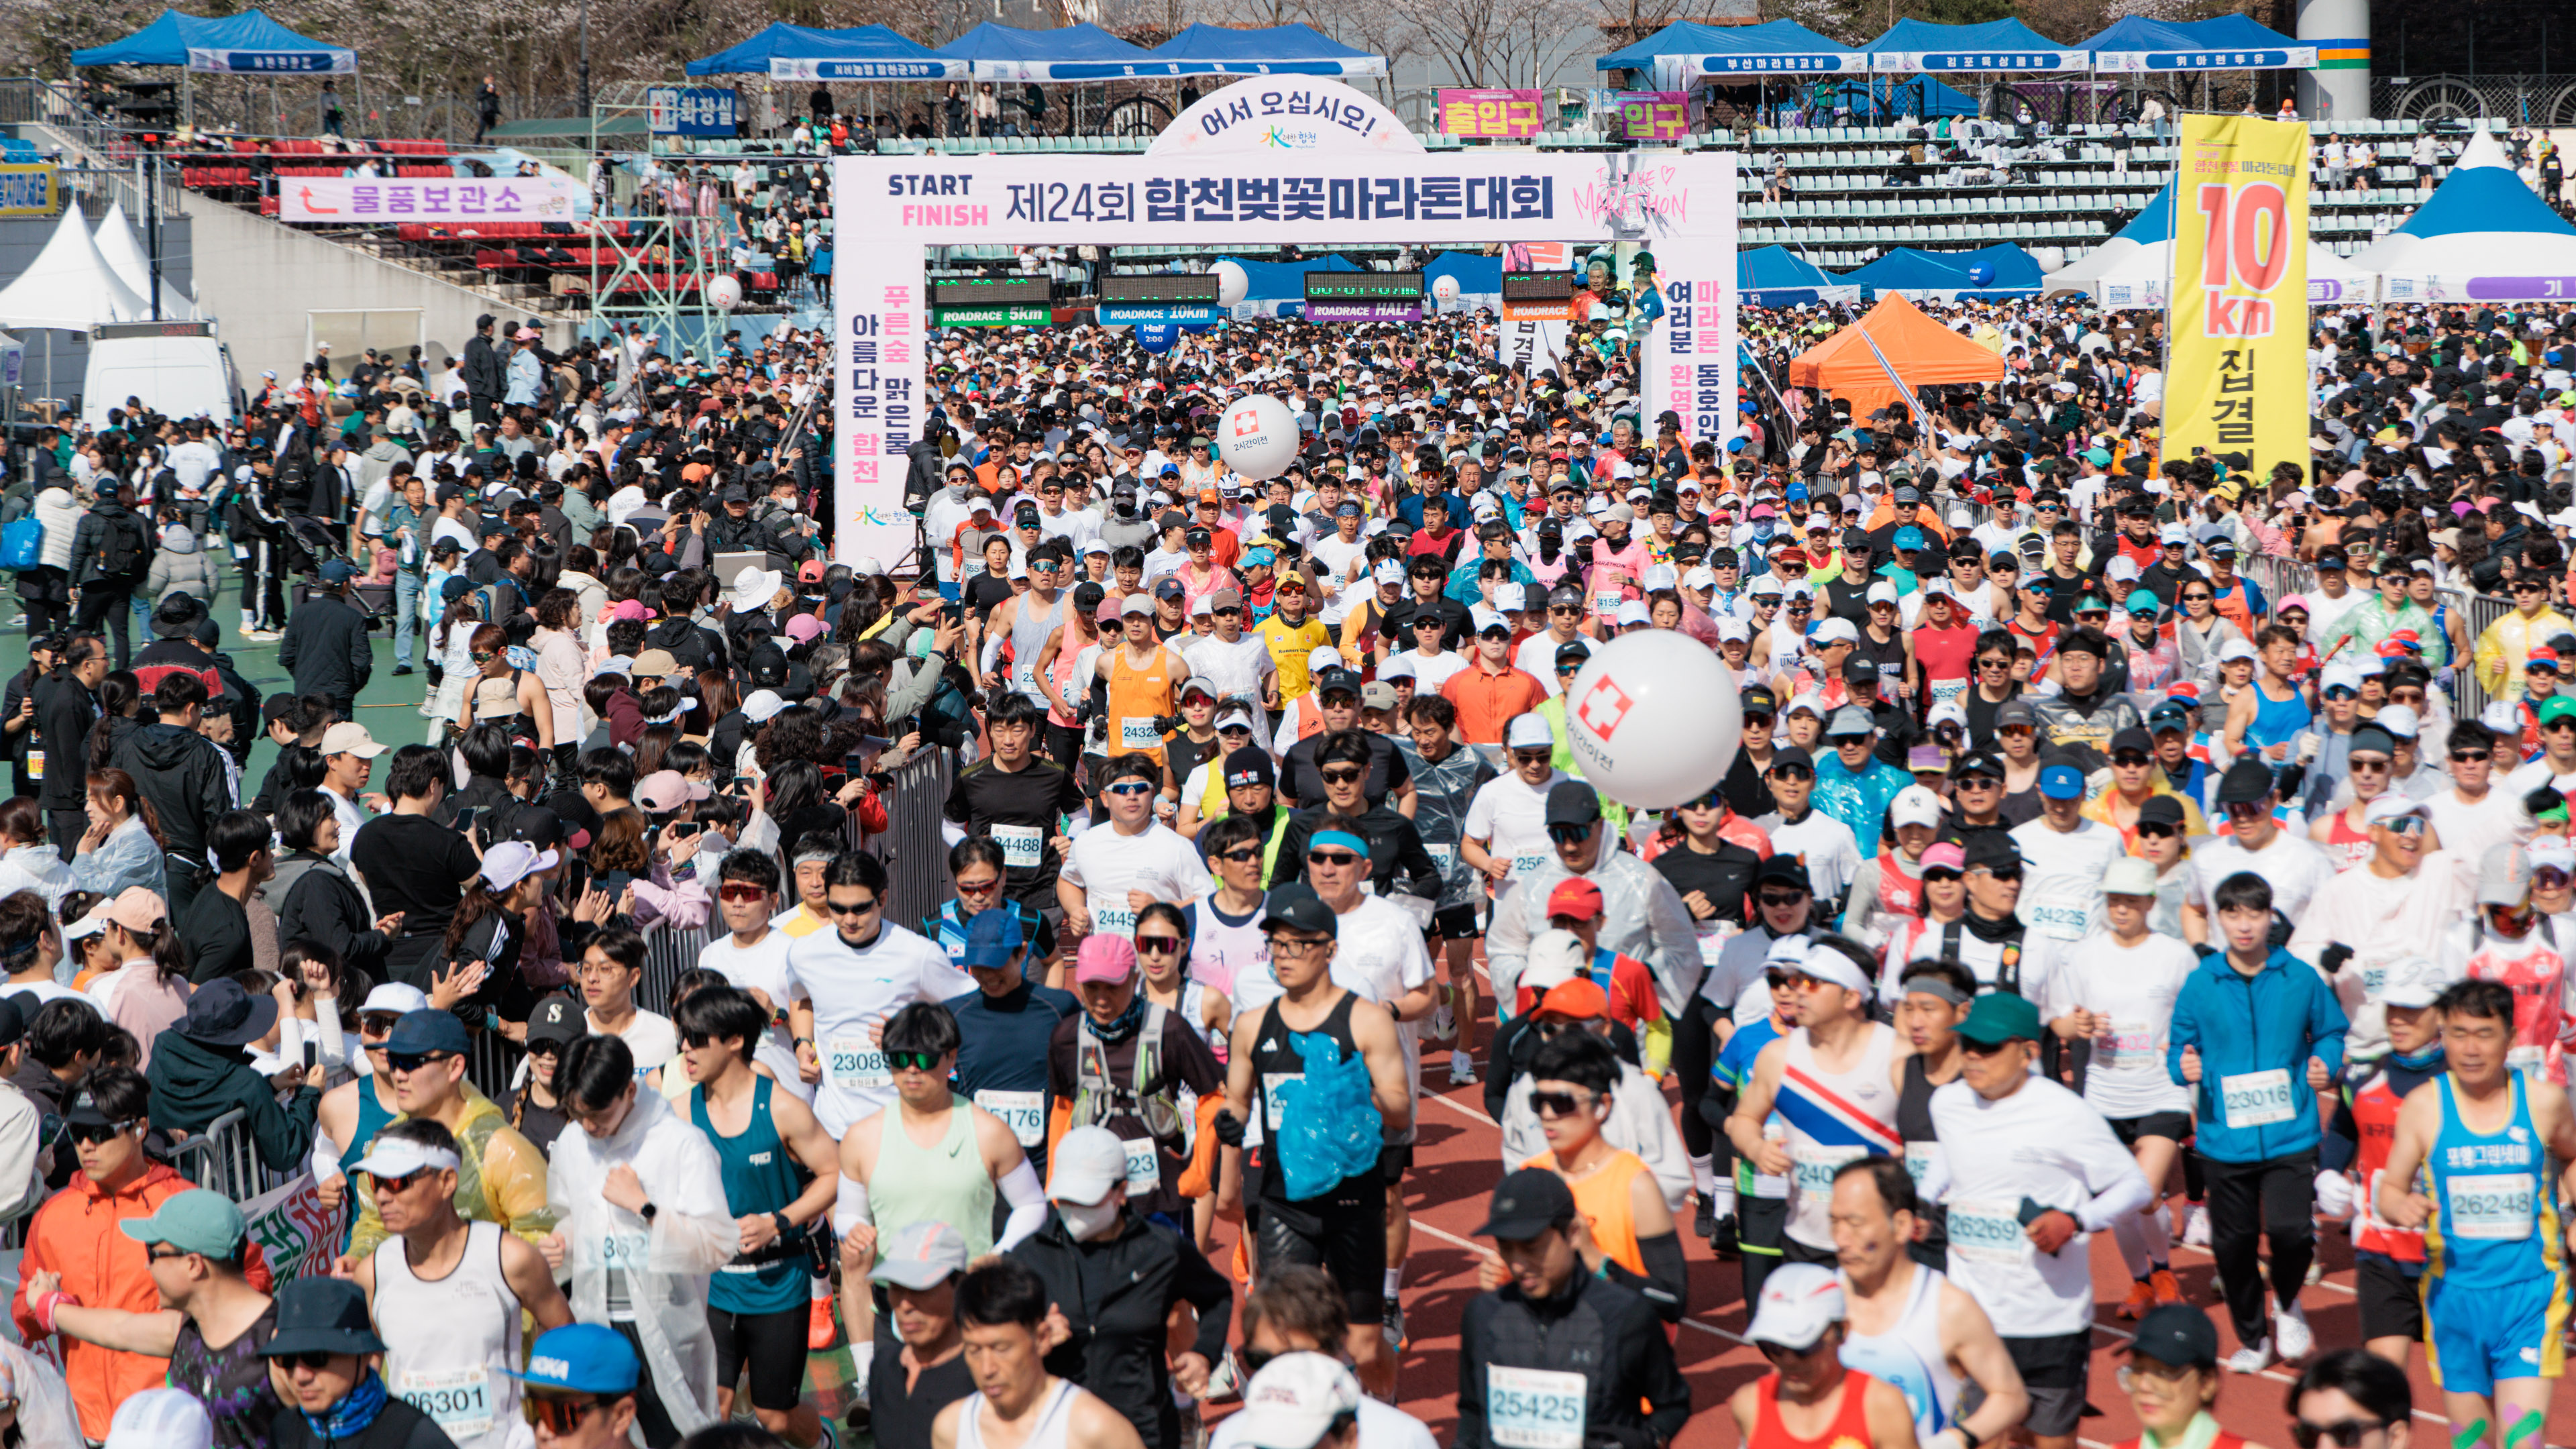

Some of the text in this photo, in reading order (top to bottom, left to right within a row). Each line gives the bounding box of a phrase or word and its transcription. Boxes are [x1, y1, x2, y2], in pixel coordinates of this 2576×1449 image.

[680, 95, 733, 126] 화장실
[1201, 91, 1377, 138] 어서 오십시오!
[1446, 101, 1539, 135] 출입구
[1616, 167, 1656, 186] LOVE
[2194, 160, 2218, 174] 합천
[889, 174, 973, 195] START
[352, 186, 522, 213] 물품보관소
[1006, 174, 1553, 223] 제24회 합천벚꽃마라톤대회
[1572, 181, 1688, 223] MARATHON
[902, 204, 989, 227] FINISH
[2199, 182, 2291, 292] 10
[942, 306, 1043, 323] ROADRACE 5km
[1110, 305, 1208, 320] ROADRACE 10km
[1314, 302, 1414, 317] ROADRACE HALF
[1513, 305, 1569, 317] ROADRACE
[1669, 280, 1693, 355] 여러분
[1142, 323, 1166, 334] Half
[883, 285, 912, 455] 푸른숲 맑은물
[1697, 280, 1721, 441] 마라톤 동호인
[851, 313, 880, 484] 아름다운 합천
[1234, 435, 1269, 451] 2시간이전
[2033, 906, 2086, 926] 24225
[547, 1004, 563, 1024] S
[2226, 1084, 2289, 1111] 23016
[2453, 1193, 2531, 1217] 26248
[1948, 1213, 2019, 1242] 26269
[1491, 1389, 1579, 1422] 25425
